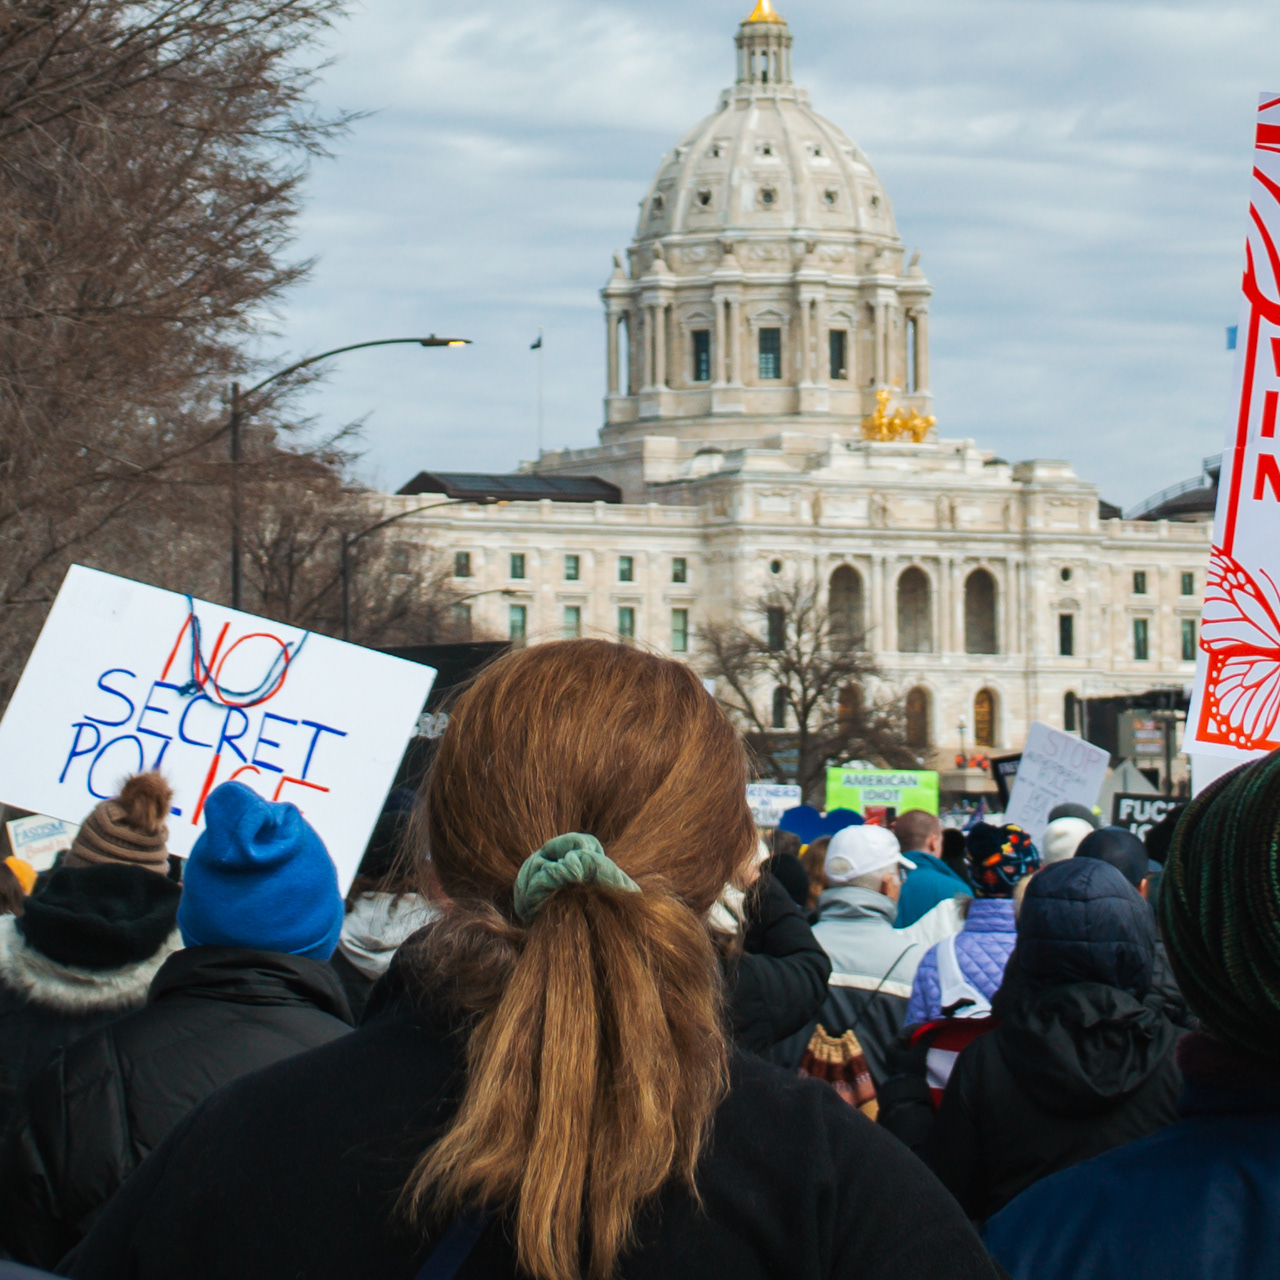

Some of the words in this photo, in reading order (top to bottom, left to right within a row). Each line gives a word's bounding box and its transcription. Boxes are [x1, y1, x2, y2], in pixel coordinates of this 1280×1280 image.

[161, 612, 291, 708] NO
[83, 668, 348, 780] SECRET
[1042, 730, 1101, 772] STOP
[843, 774, 918, 786] AMERICAN
[862, 789, 900, 801] IDIOT
[1119, 798, 1181, 823] FUC
